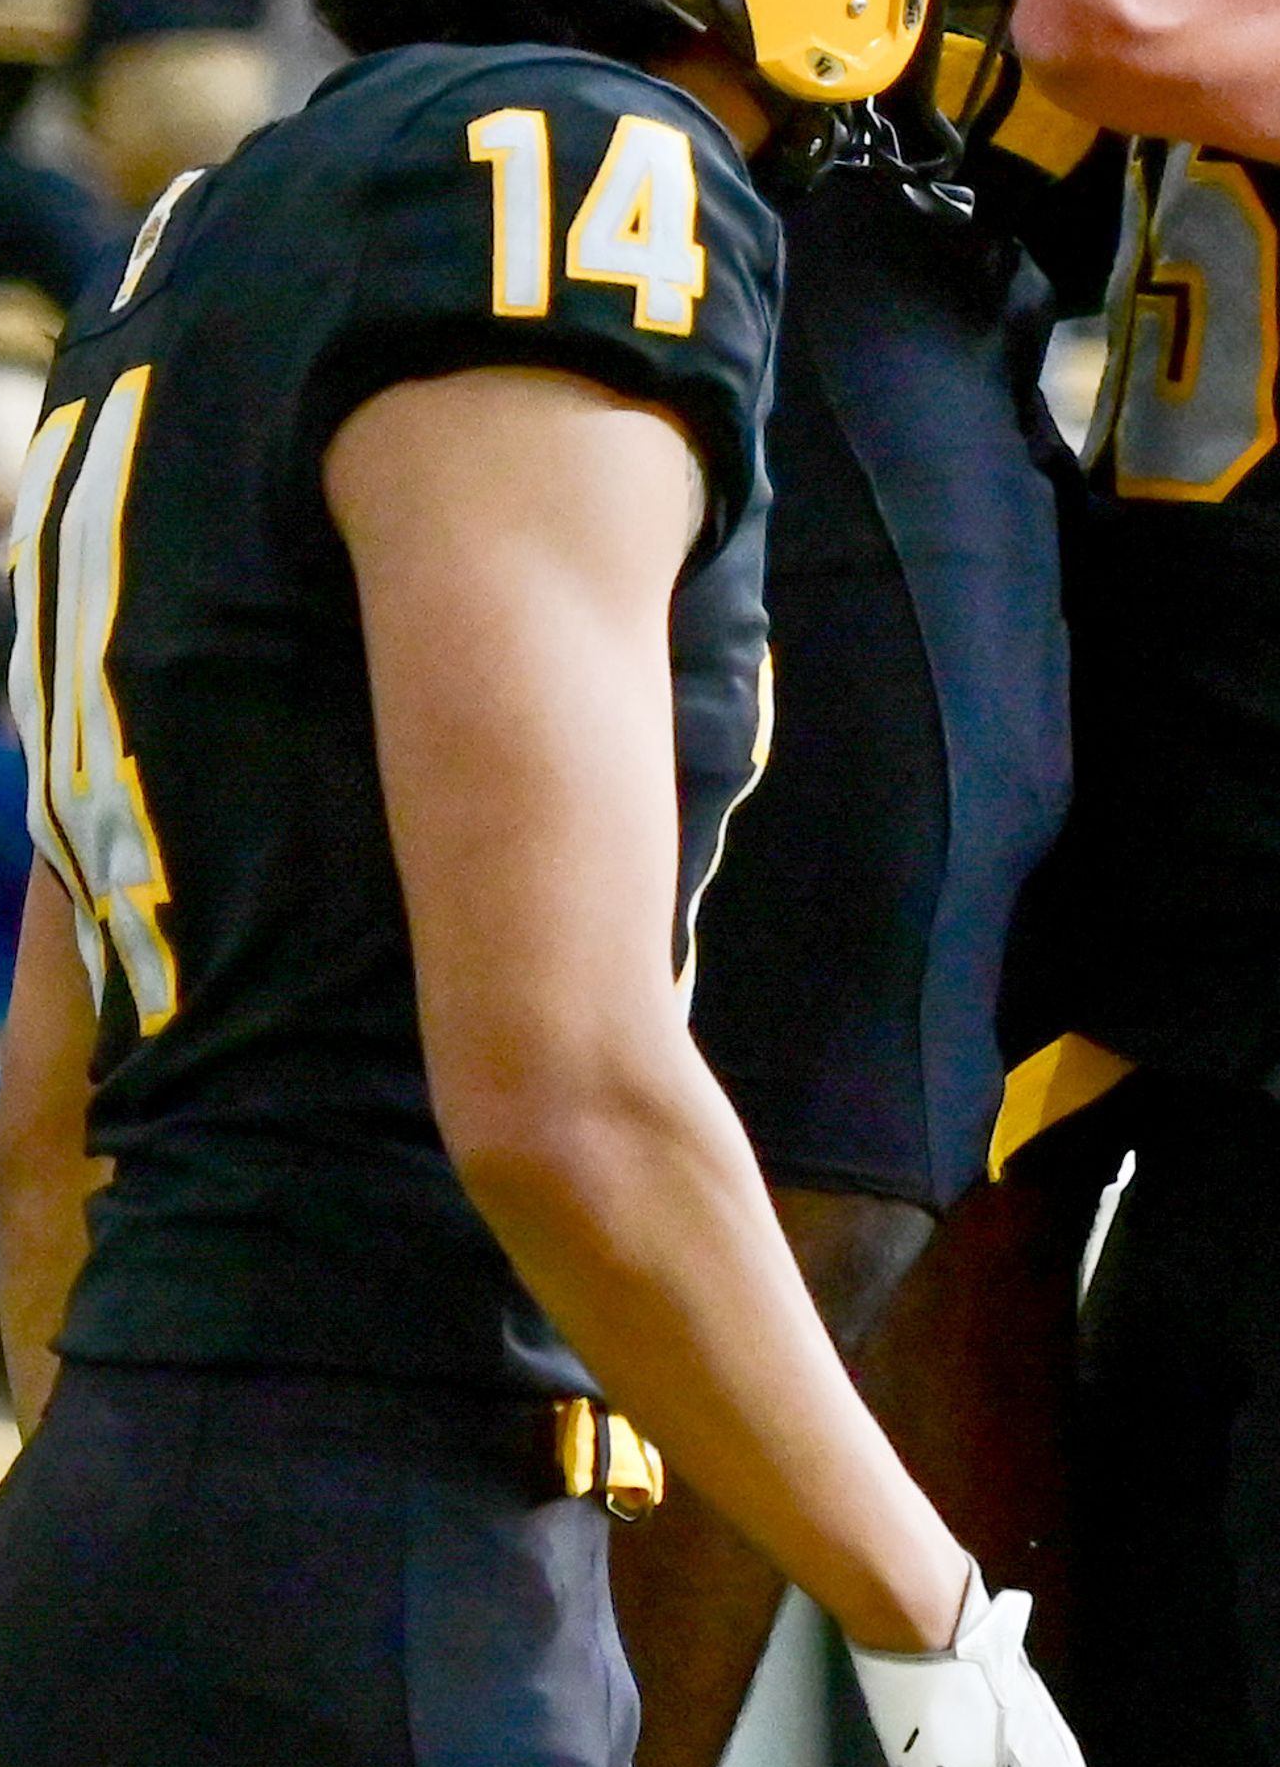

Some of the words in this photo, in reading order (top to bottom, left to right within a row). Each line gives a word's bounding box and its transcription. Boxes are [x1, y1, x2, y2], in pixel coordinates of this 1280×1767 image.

[467, 107, 706, 336] 14
[1078, 136, 1280, 502] 5
[7, 363, 180, 1037] 14
